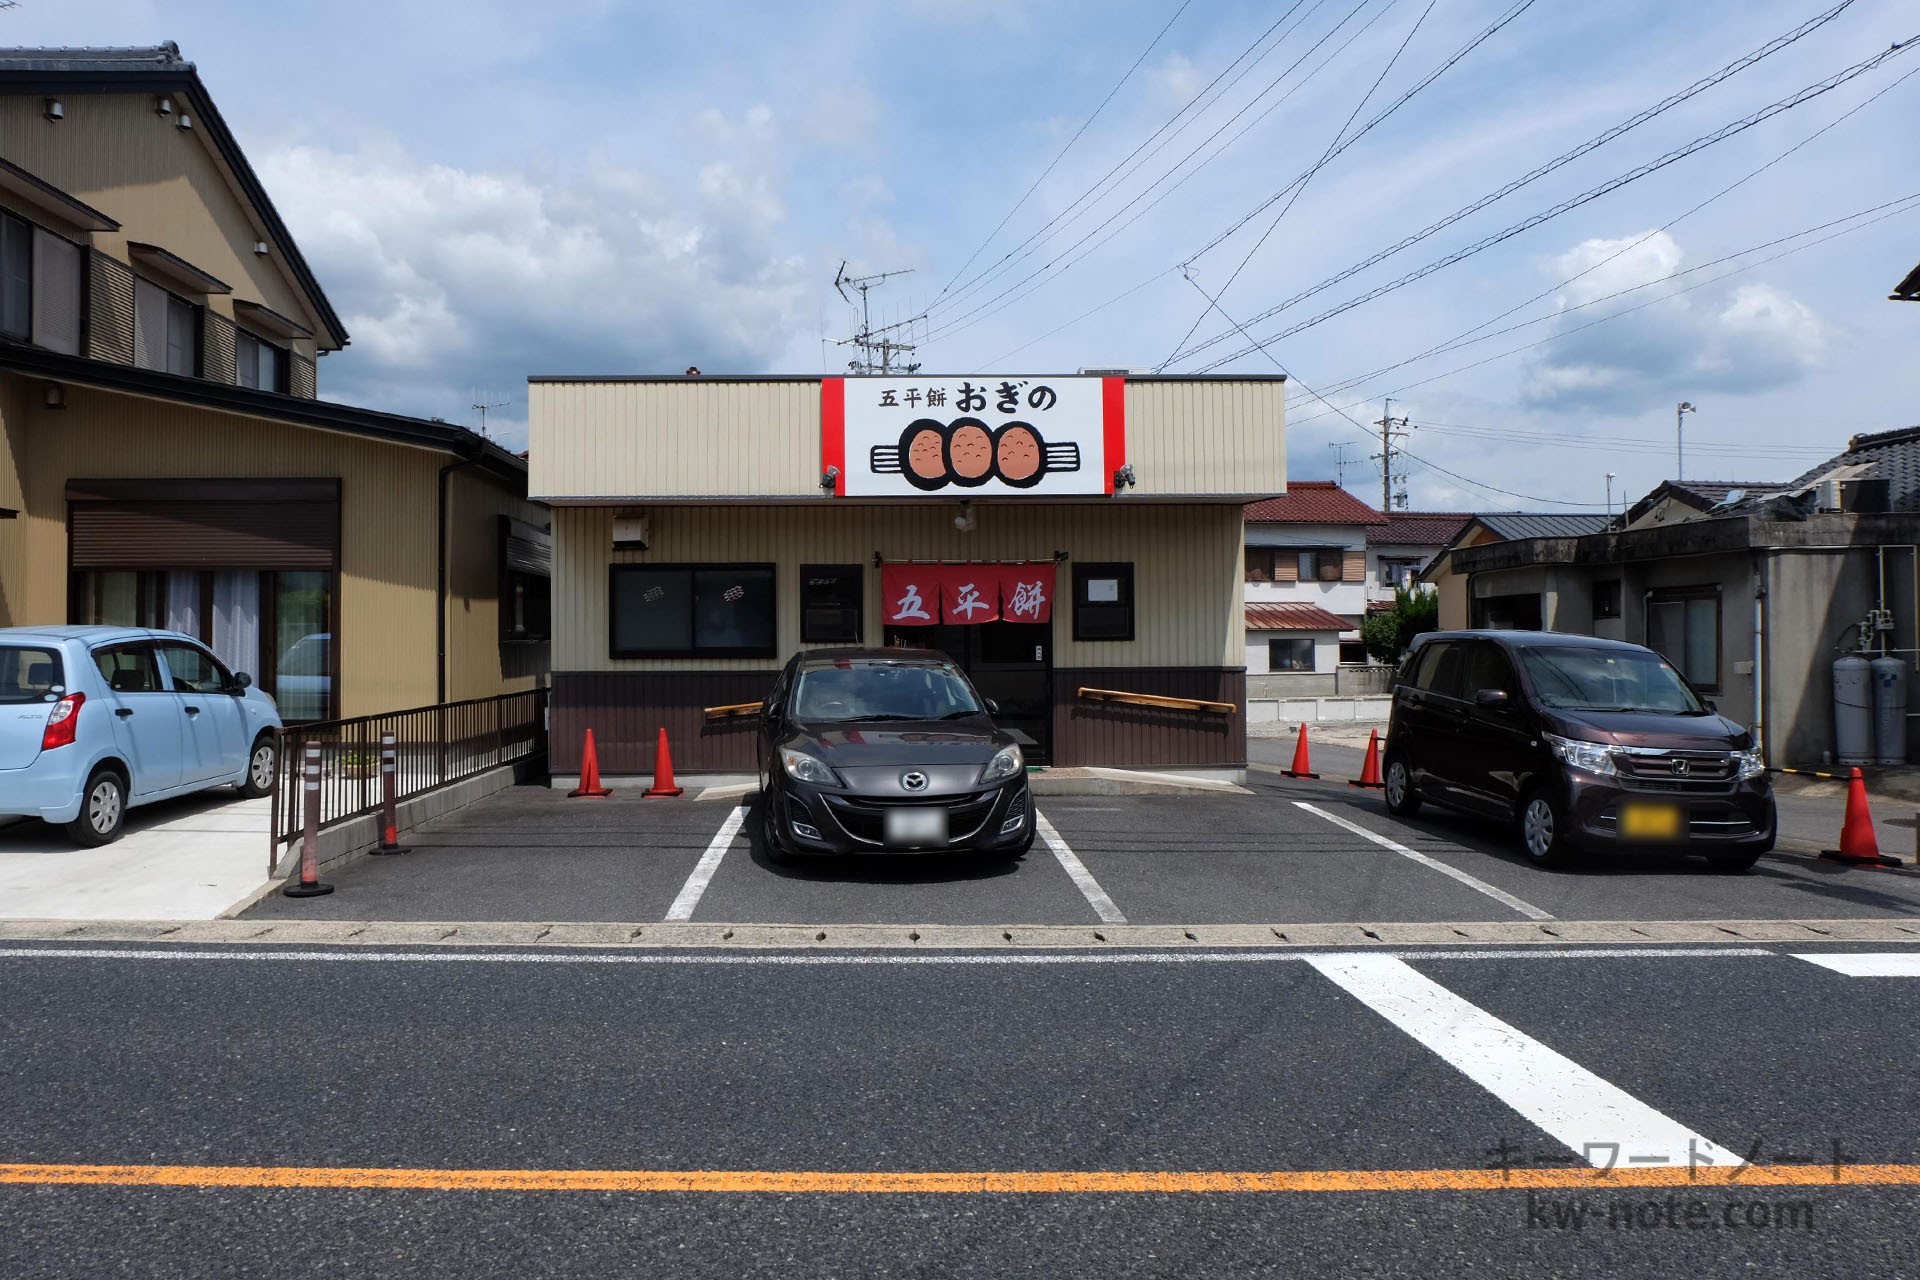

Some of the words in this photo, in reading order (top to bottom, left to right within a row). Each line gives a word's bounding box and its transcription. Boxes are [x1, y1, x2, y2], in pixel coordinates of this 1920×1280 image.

[878, 387, 948, 409] 五平餅
[955, 381, 1057, 413] おぎの
[891, 580, 1047, 621] 五平餅
